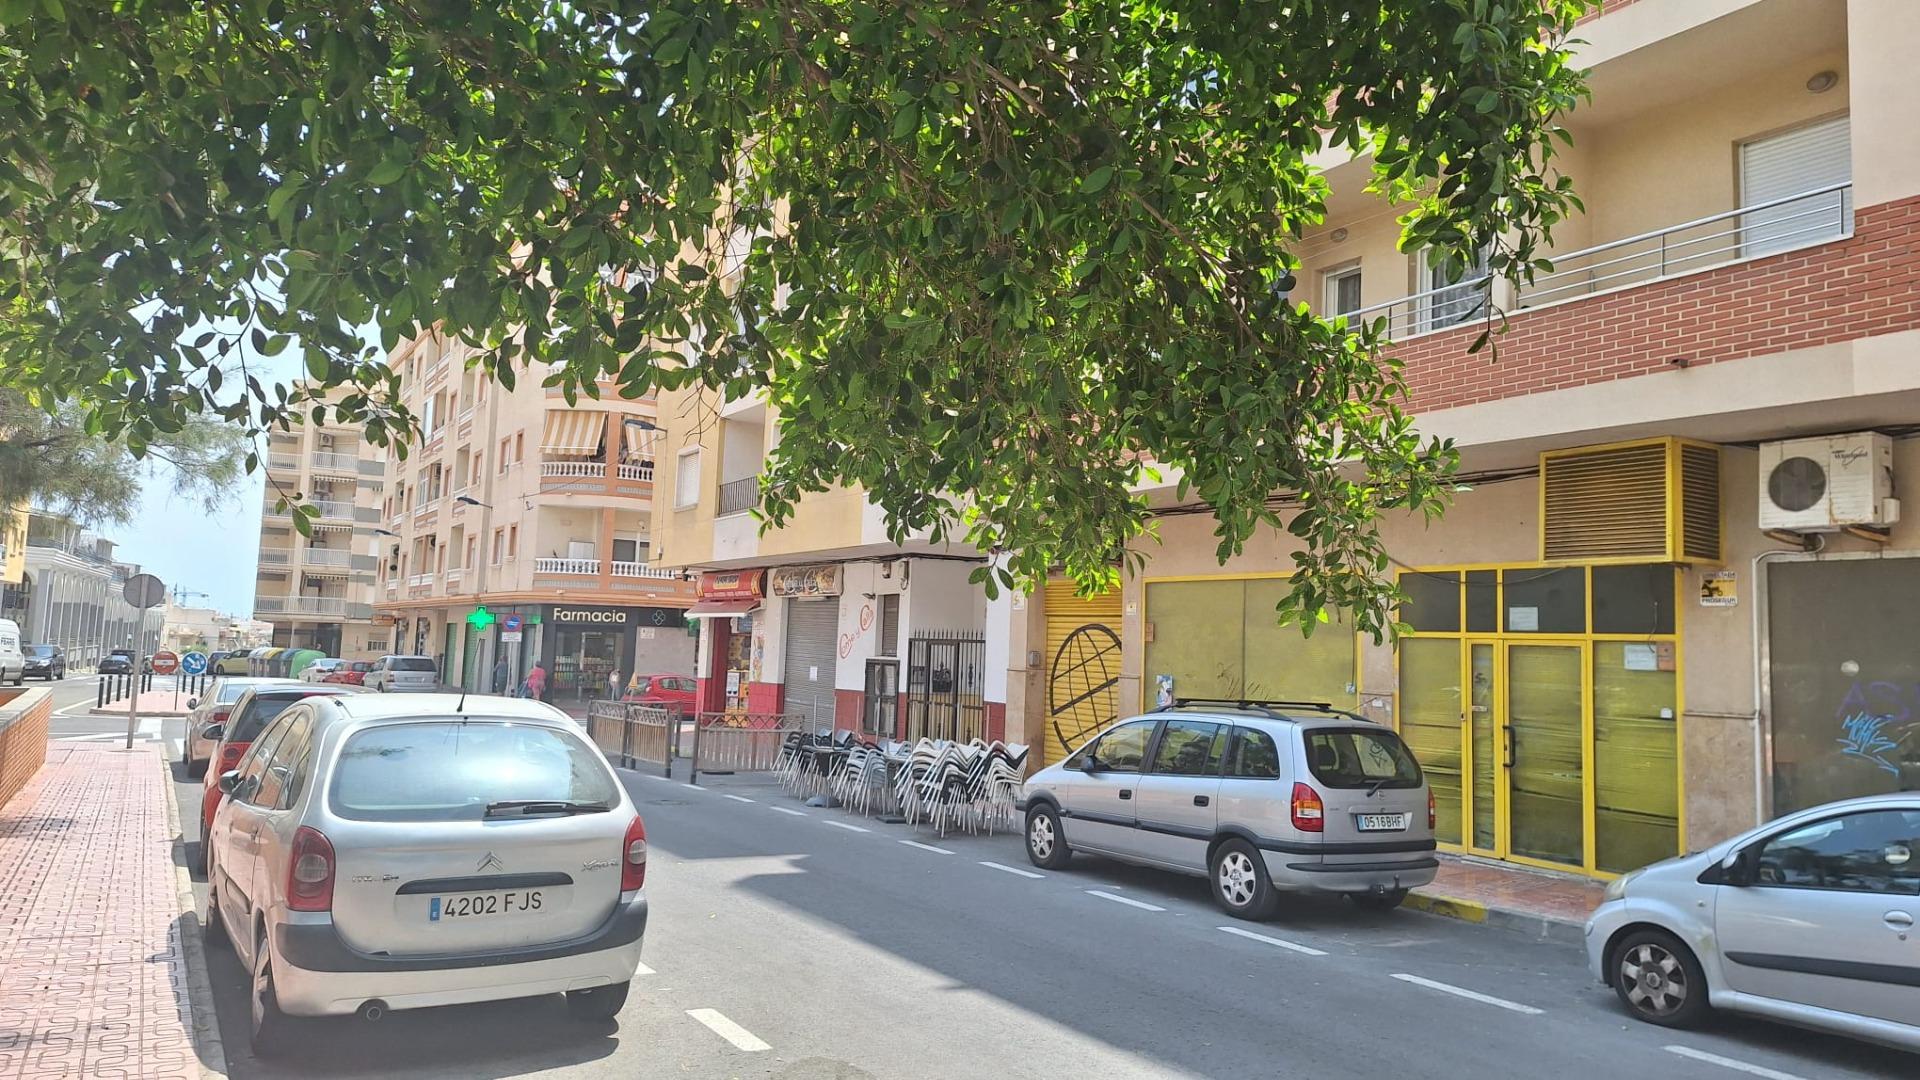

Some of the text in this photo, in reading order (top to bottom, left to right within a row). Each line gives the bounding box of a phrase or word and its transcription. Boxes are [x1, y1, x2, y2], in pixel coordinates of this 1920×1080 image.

[553, 607, 626, 623] Farmacia
[1364, 816, 1402, 828] 0516BHF
[444, 891, 542, 917] 4202 FJS
